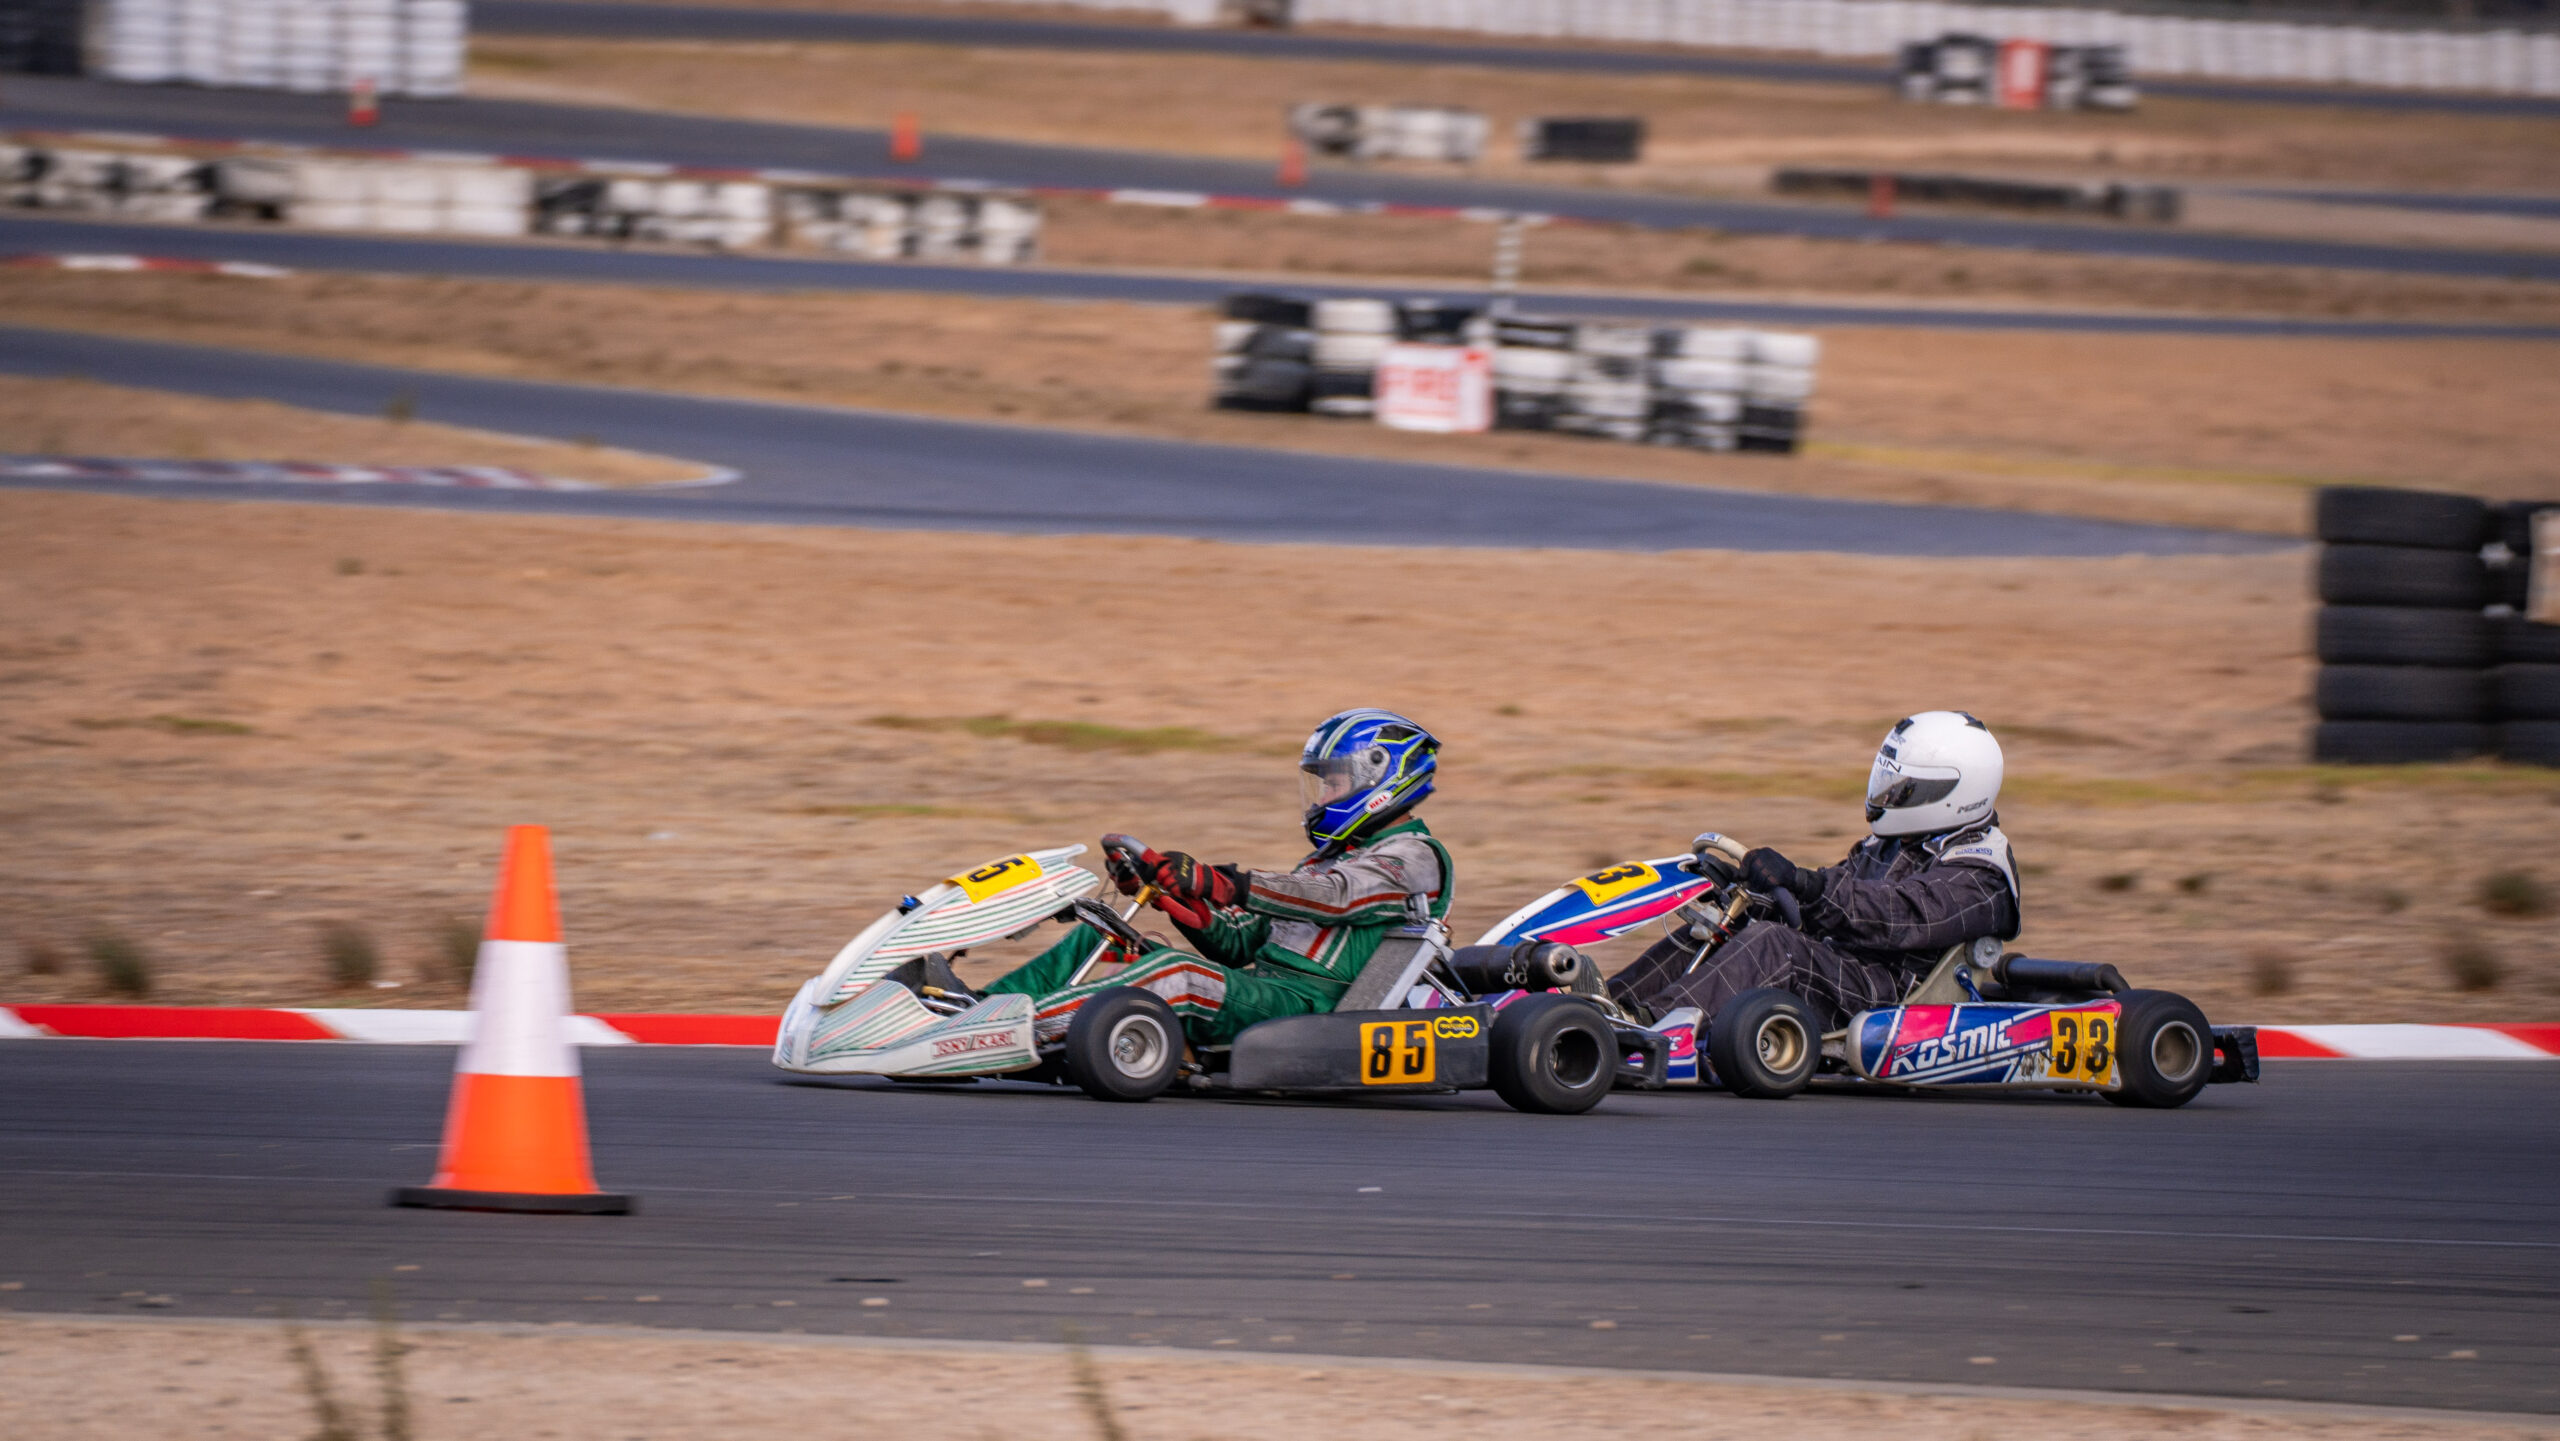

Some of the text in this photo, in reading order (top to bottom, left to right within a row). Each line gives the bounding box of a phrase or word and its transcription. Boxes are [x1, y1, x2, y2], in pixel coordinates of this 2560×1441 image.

[1368, 794, 1388, 810] BELL
[1369, 1022, 1427, 1079] 85
[1889, 1018, 2014, 1076] KOSMIC
[2054, 1017, 2110, 1075] 33
